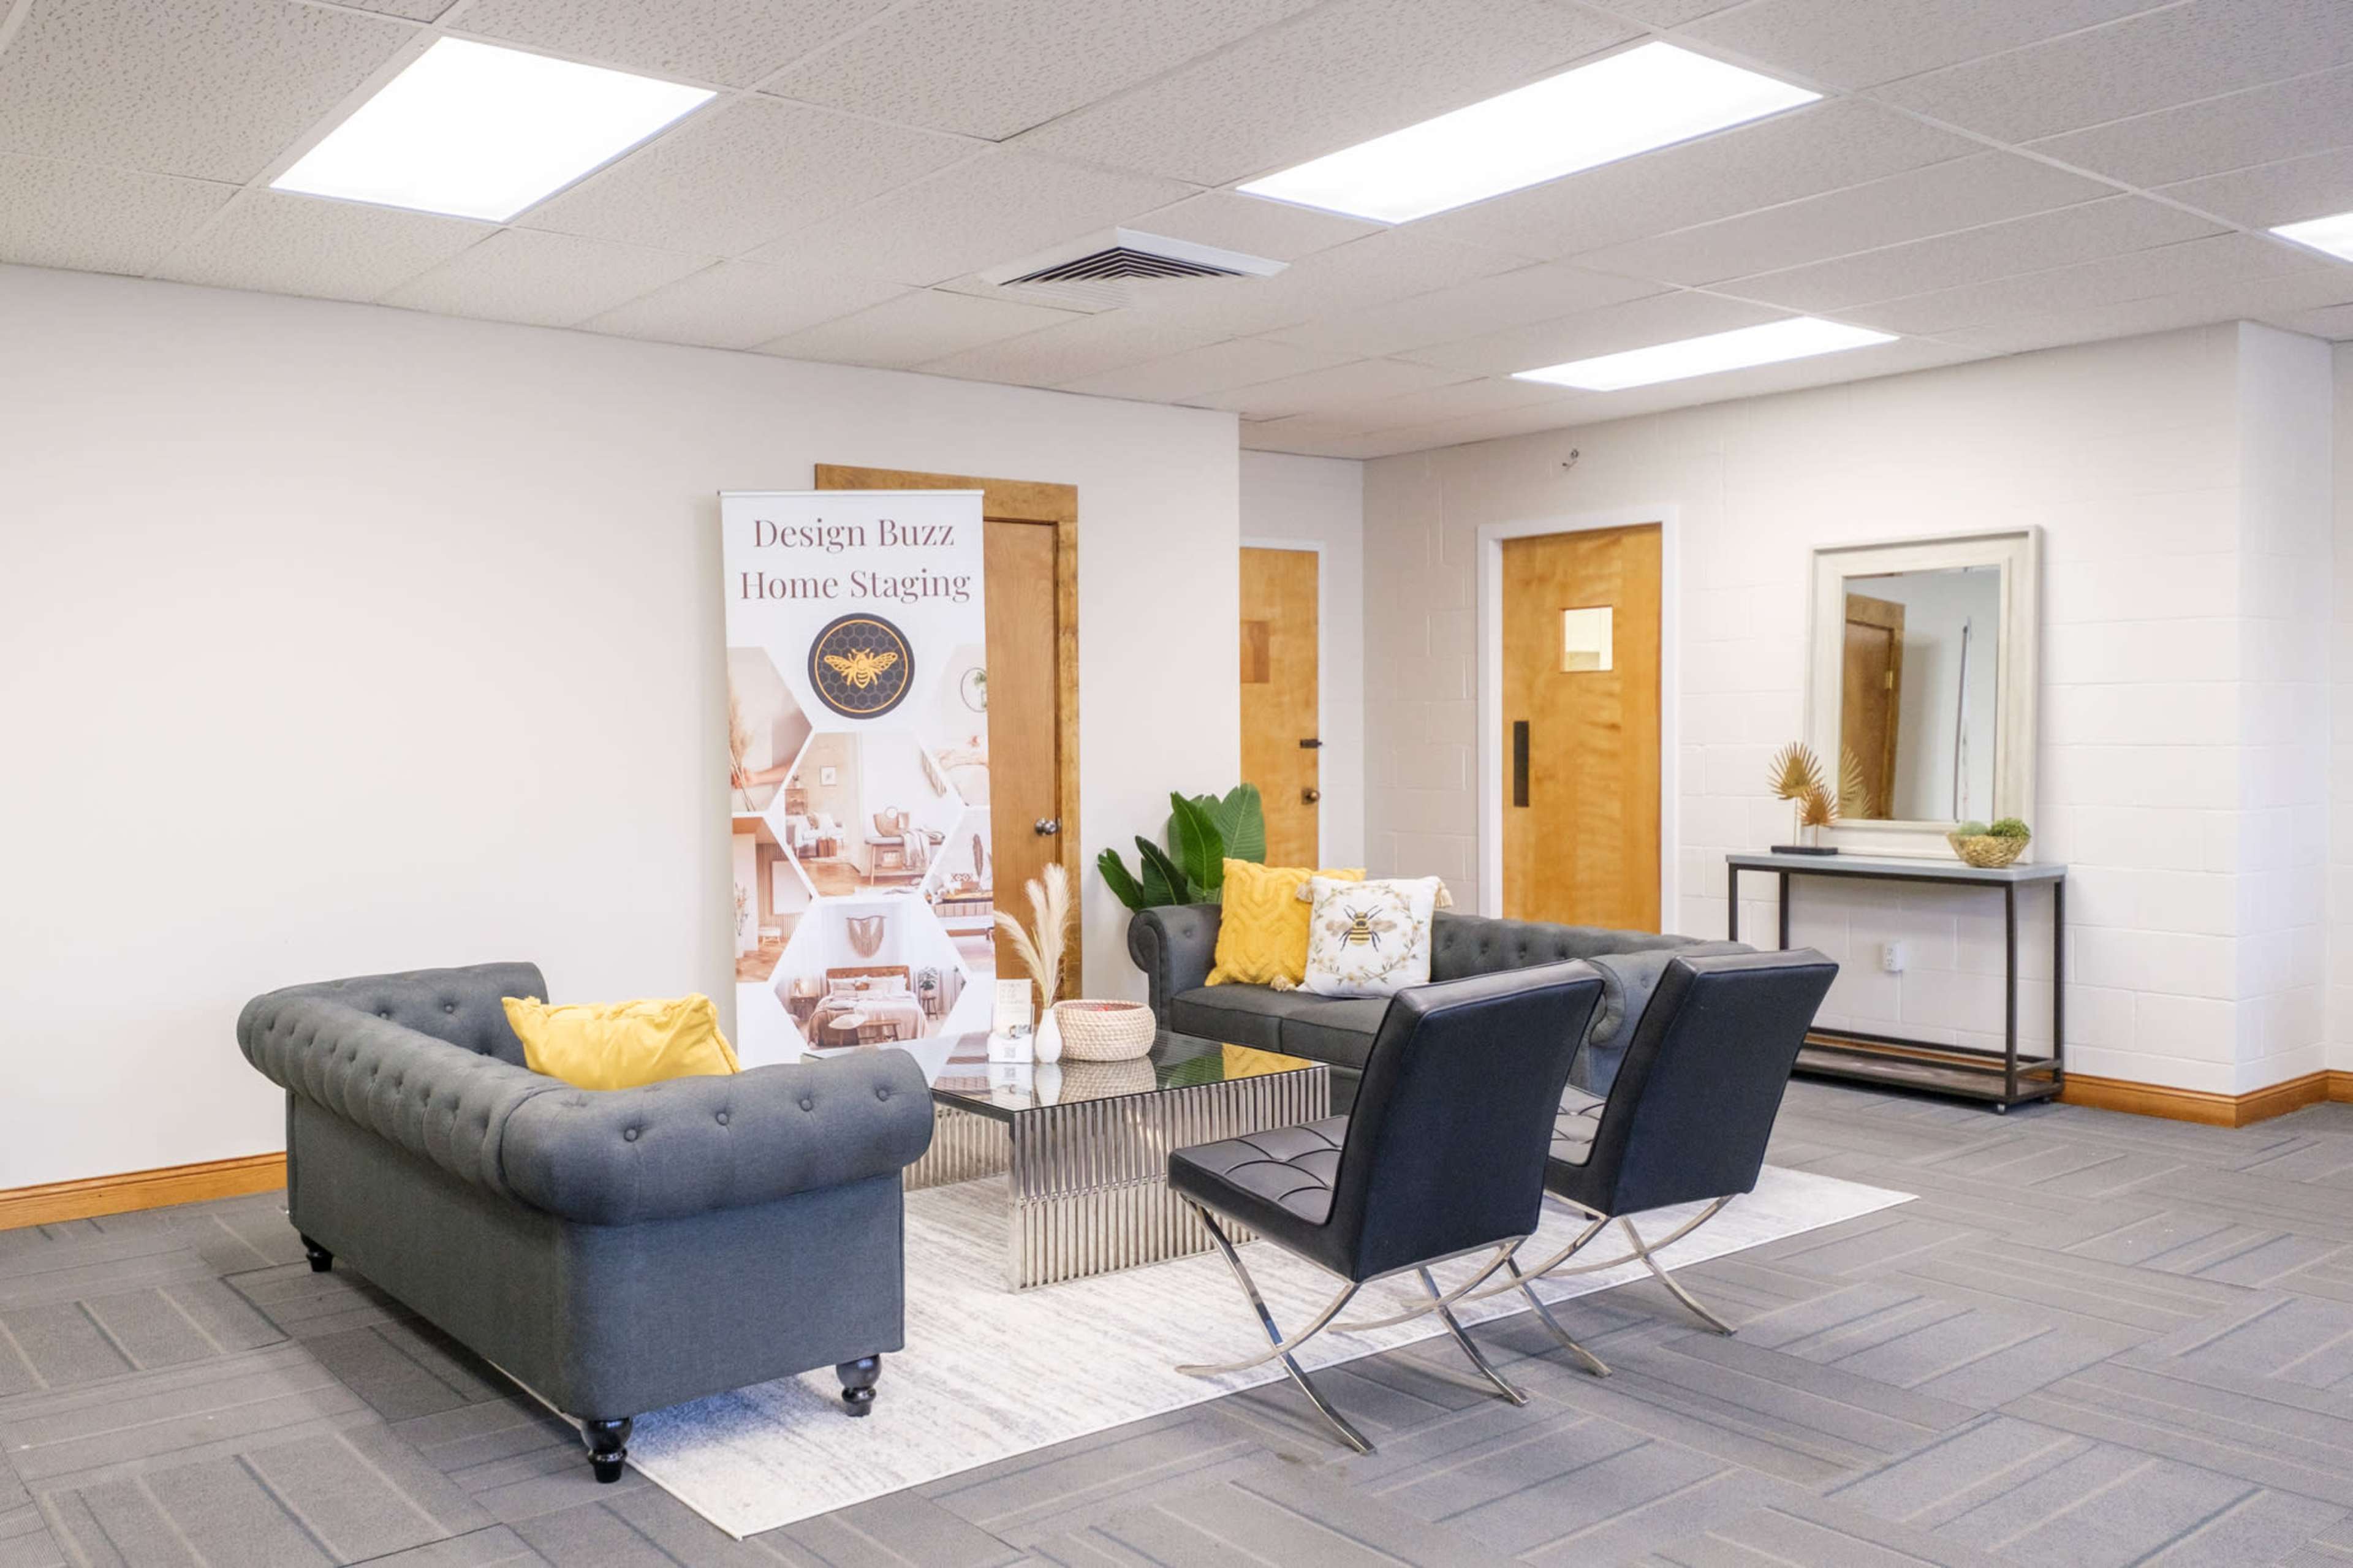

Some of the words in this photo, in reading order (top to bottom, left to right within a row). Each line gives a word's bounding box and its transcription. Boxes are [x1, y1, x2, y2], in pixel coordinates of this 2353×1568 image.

[753, 518, 868, 553] Design
[879, 518, 955, 547] Buzz
[740, 571, 839, 599] Home
[850, 568, 971, 604] Staging
